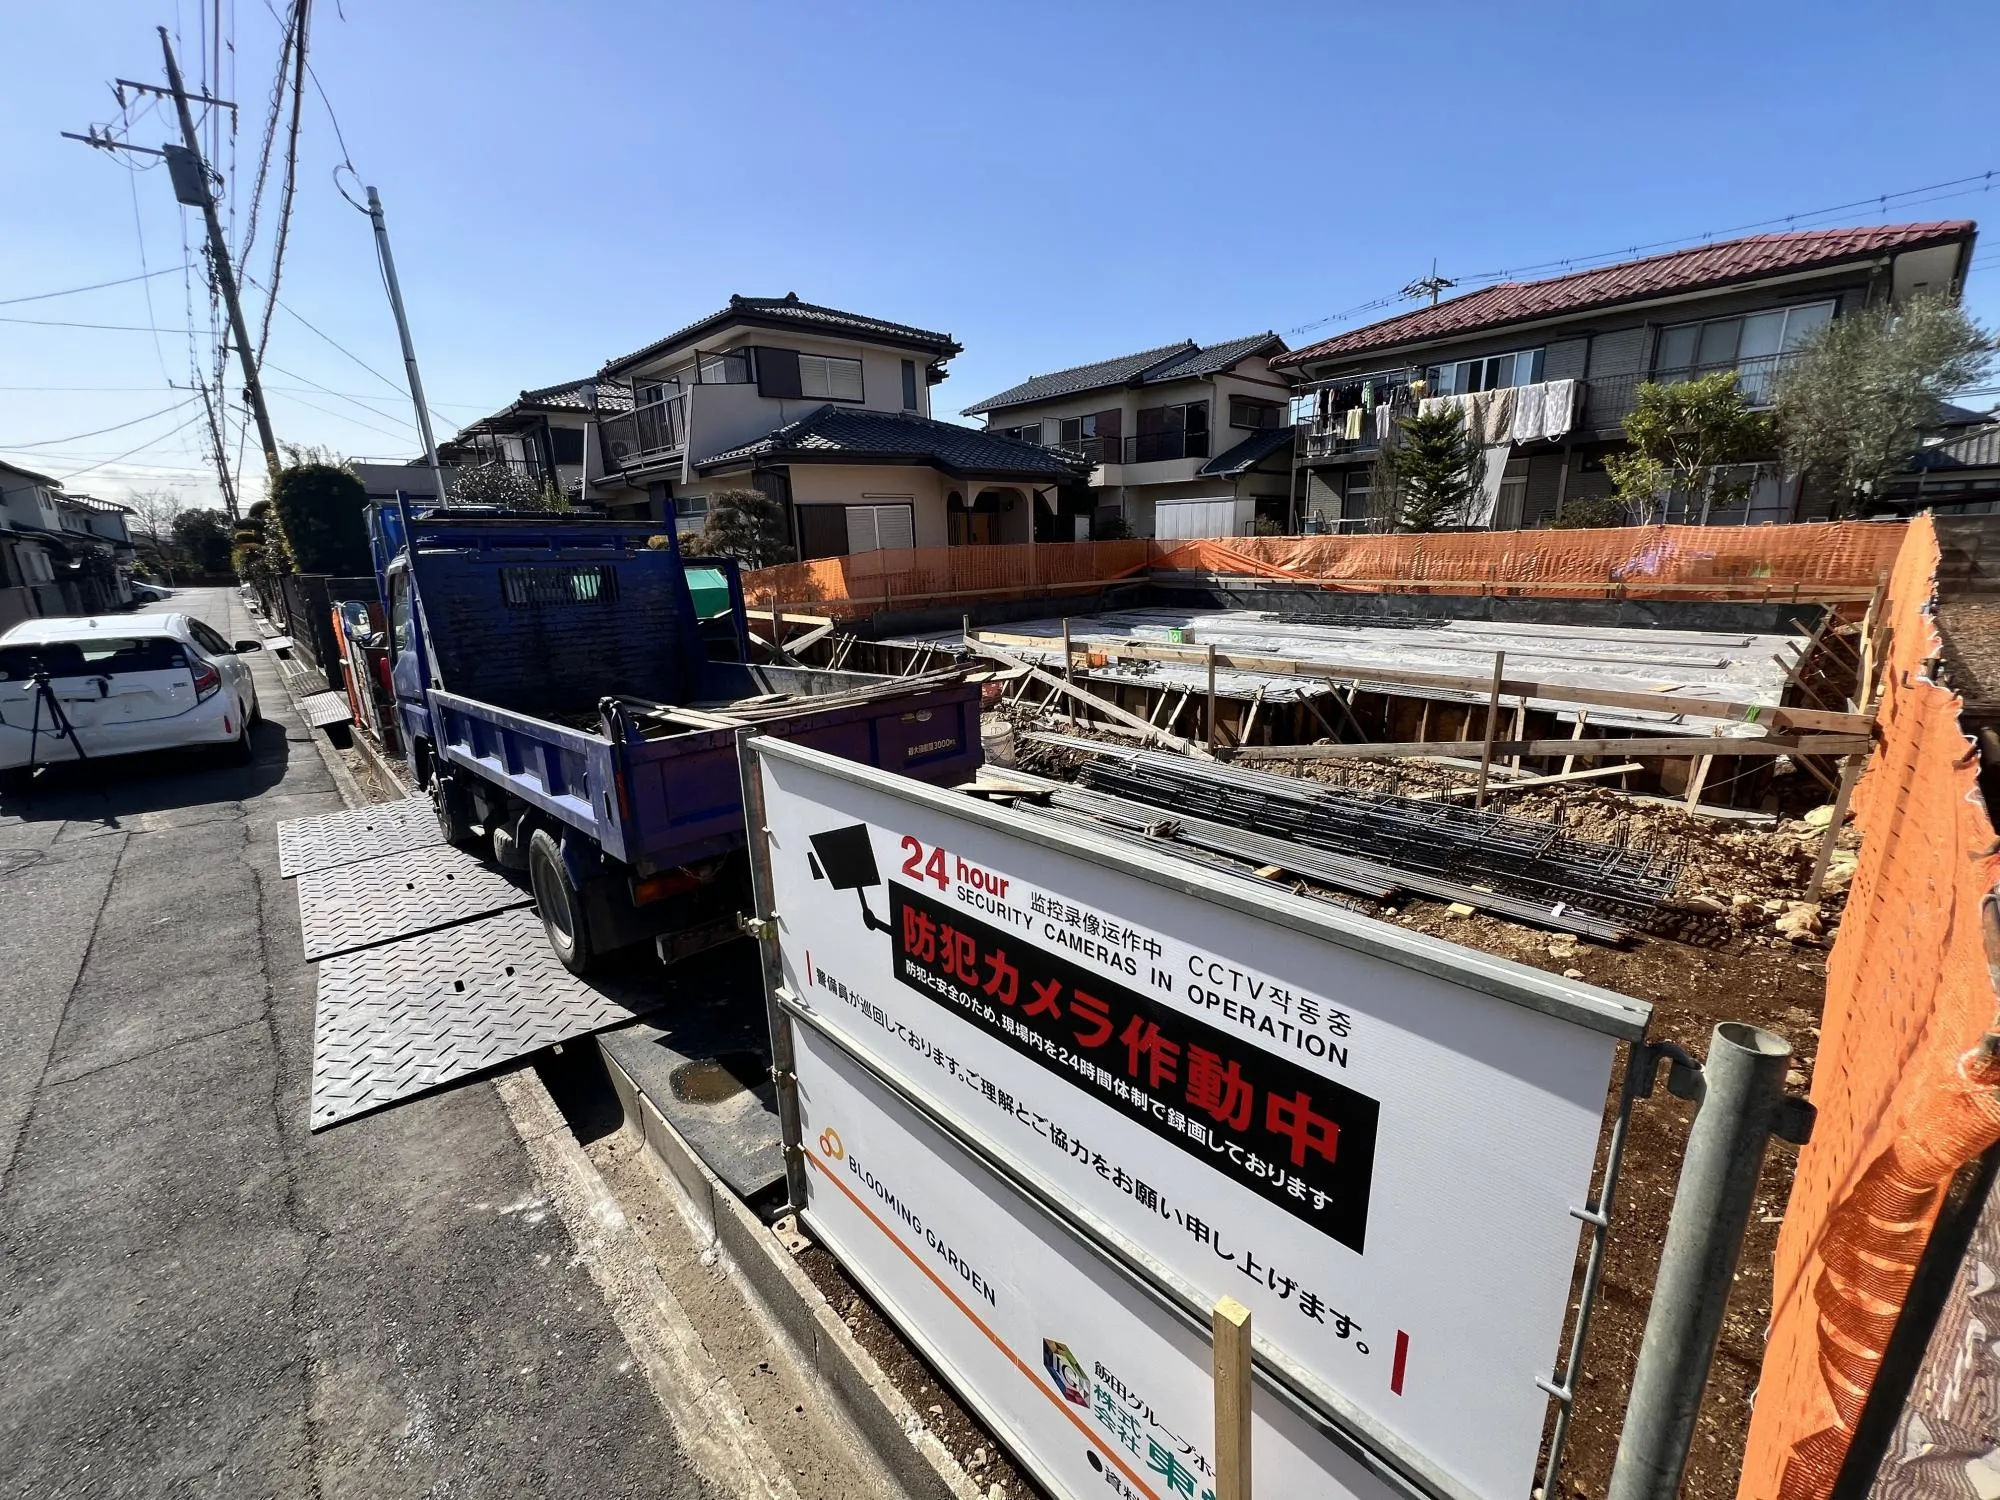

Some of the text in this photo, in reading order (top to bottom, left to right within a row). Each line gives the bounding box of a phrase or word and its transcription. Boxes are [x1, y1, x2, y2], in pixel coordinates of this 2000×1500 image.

[901, 835, 1010, 899] 24 hour
[957, 885, 1348, 1069] SECURITY CAMERAS IN OPERATION
[1031, 891, 1162, 961] 监控录像运作中
[902, 903, 1341, 1168] 防犯カメラ作動中
[849, 1155, 996, 1307] BLOOMING GARDEN
[1094, 1361, 1216, 1477] 飯田グループホ
[1146, 1434, 1216, 1500] 東
